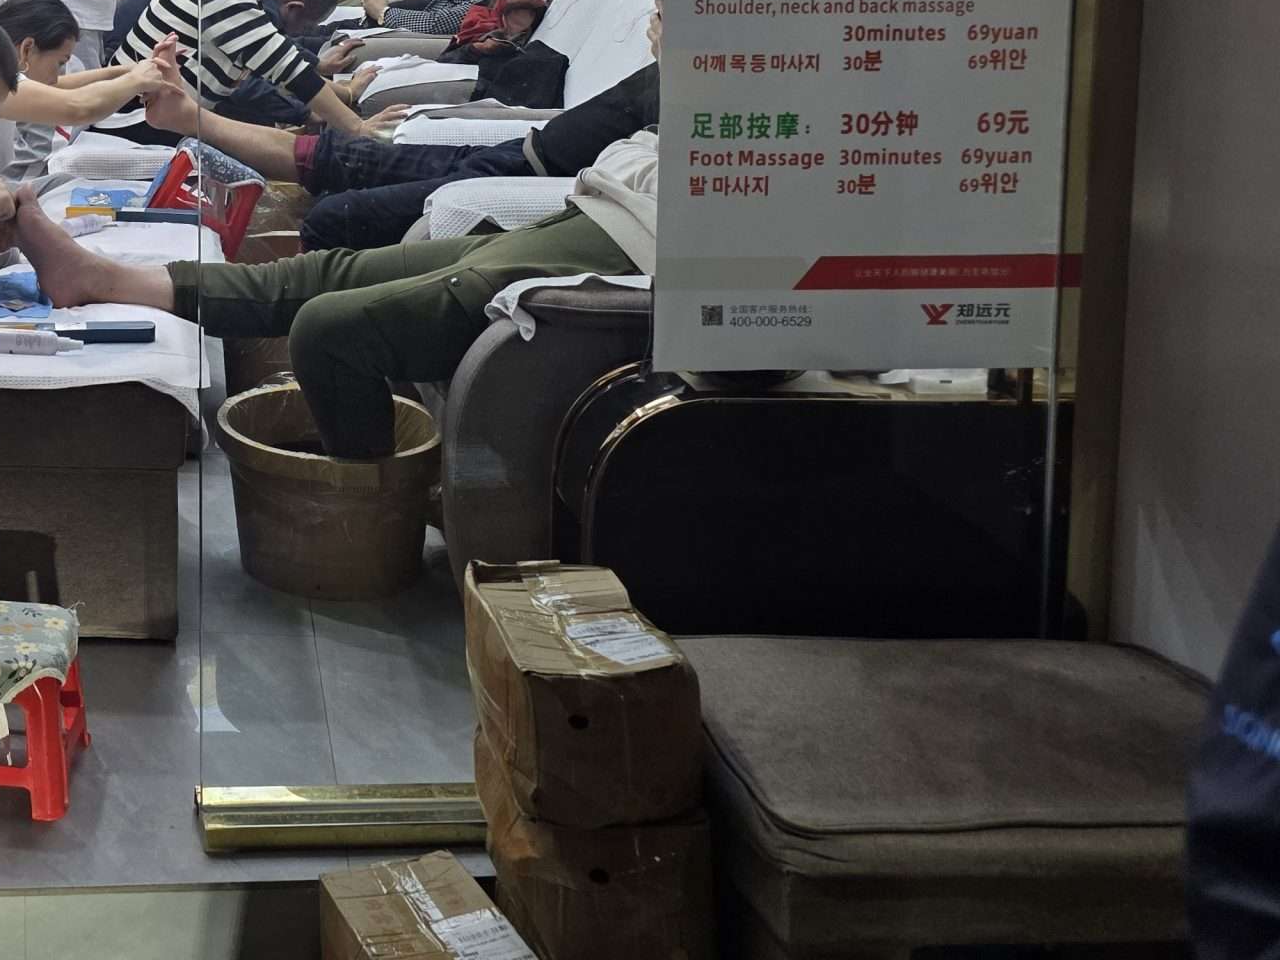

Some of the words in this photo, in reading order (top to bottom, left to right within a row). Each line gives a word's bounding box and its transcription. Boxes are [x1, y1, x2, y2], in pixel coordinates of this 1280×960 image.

[694, 0, 776, 16] Shoulder,
[781, 0, 820, 14] neck
[824, 0, 855, 14] and
[902, 0, 975, 16] massage
[843, 25, 945, 41] 30minutes
[967, 24, 1038, 43] 69yuan
[693, 54, 726, 73] 어깨
[730, 54, 746, 72] 목
[750, 54, 767, 72] 등
[771, 53, 820, 72] 마사지
[843, 51, 882, 71] 30분
[968, 50, 1027, 70] 69위안
[840, 111, 919, 135] 30分钟
[977, 110, 1029, 134] 69元
[689, 150, 732, 167] Foot
[738, 150, 825, 169] Massage
[839, 149, 942, 166] 30minutes
[961, 148, 1032, 167] 69yuan
[689, 177, 706, 196] 발
[713, 176, 770, 196] 마사지
[836, 175, 876, 194] 30분
[959, 173, 1018, 193] 69위안
[956, 303, 1011, 319] 郑远元
[729, 316, 812, 327] 400-000-6529
